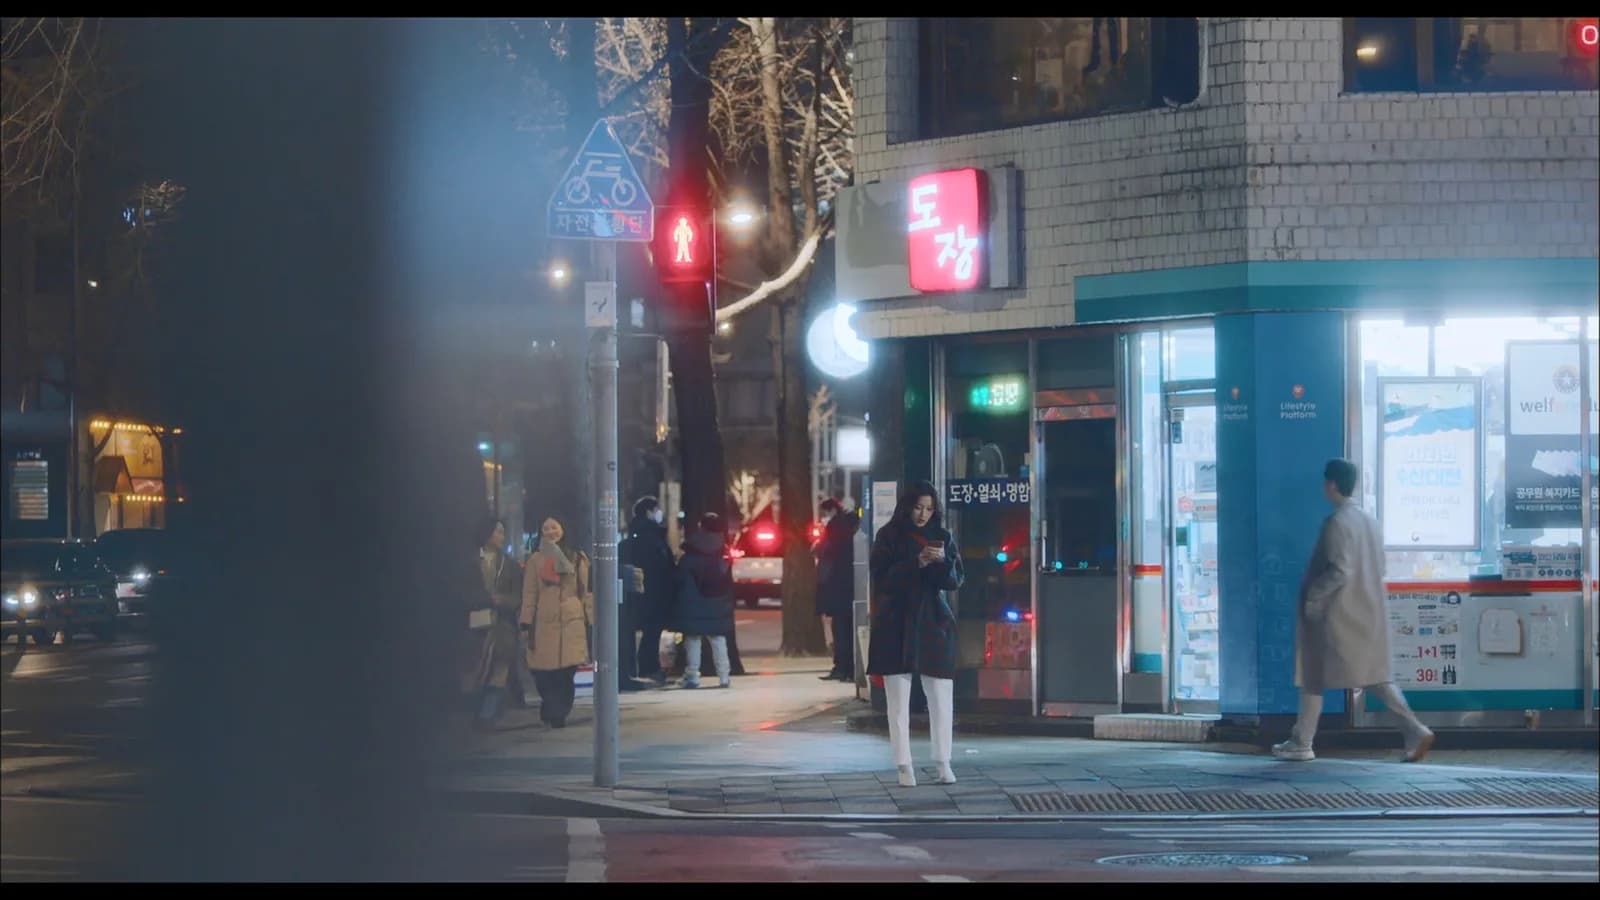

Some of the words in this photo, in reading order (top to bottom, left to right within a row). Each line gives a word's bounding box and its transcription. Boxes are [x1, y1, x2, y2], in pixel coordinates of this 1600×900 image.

[908, 184, 979, 281] 도장
[1280, 402, 1316, 412] Lifestyle
[1280, 411, 1317, 419] Platform
[1418, 646, 1437, 658] 1+1
